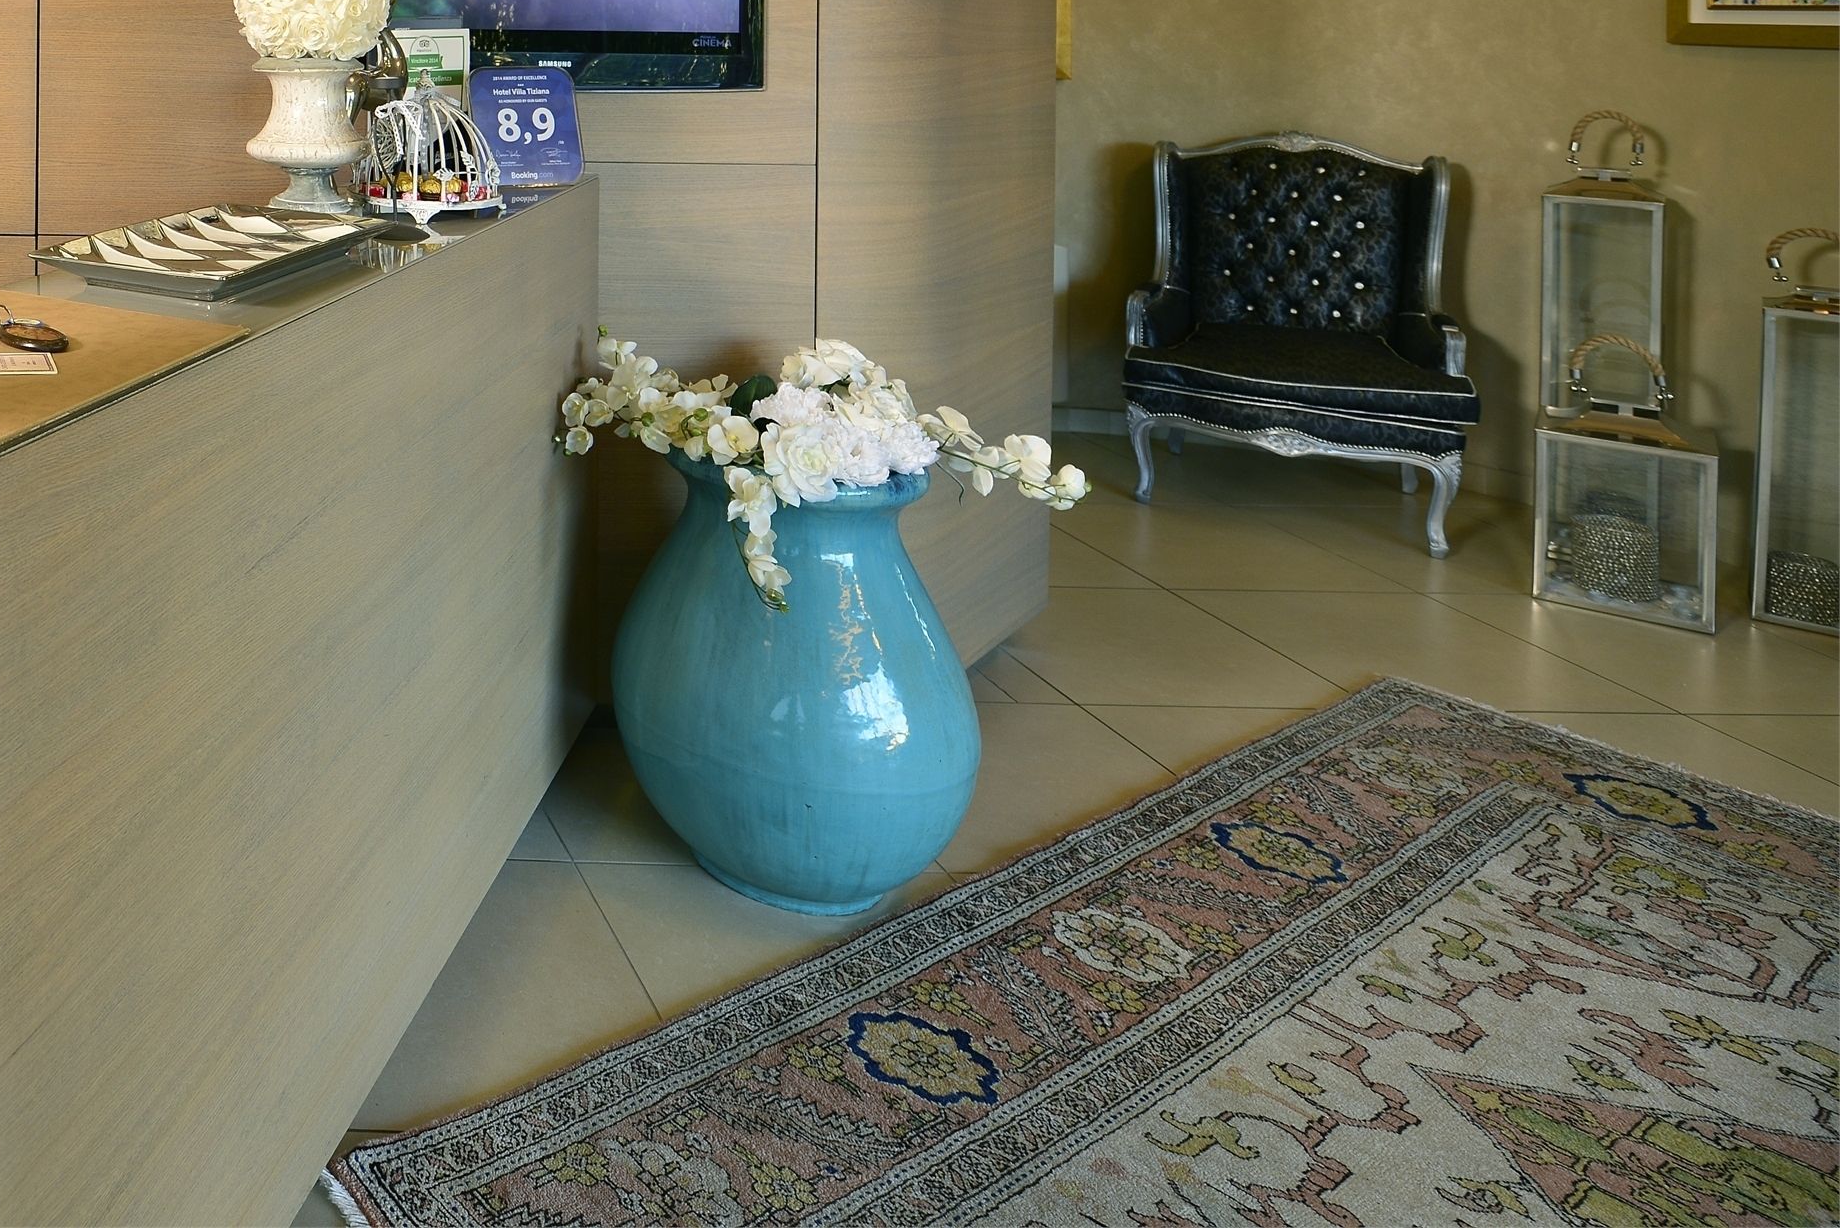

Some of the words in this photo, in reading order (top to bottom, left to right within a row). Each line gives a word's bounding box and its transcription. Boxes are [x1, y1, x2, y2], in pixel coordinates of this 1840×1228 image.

[692, 38, 732, 48] CINEMA
[538, 60, 572, 68] SAMSUNG
[492, 88, 511, 96] Hotel
[526, 87, 550, 95] Tiziana
[497, 106, 556, 145] 8,9
